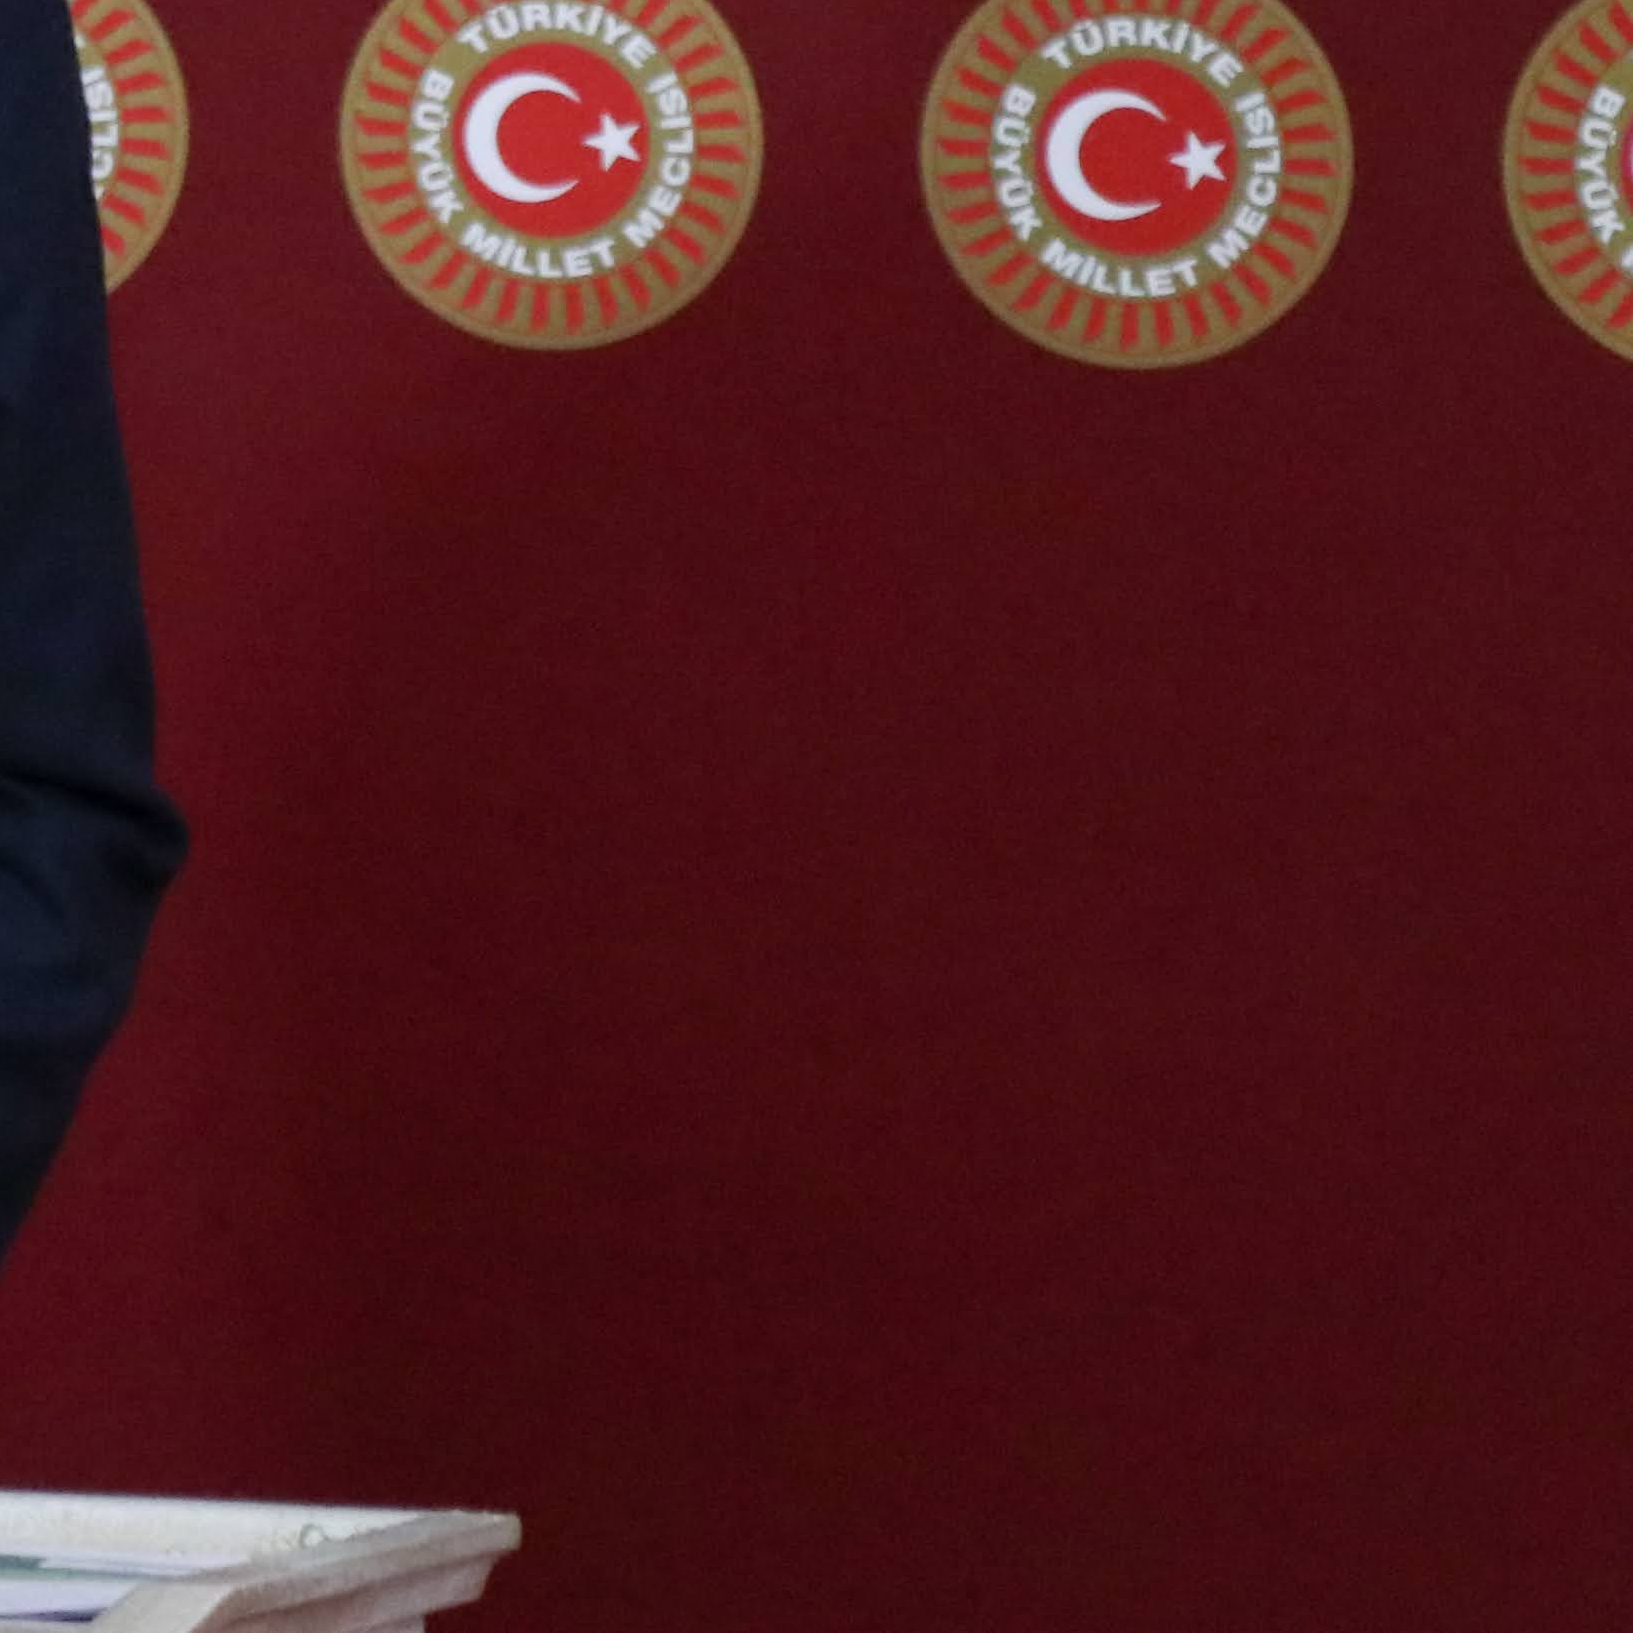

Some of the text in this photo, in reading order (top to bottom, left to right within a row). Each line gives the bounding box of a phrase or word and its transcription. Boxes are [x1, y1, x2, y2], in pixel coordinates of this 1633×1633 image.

[410, 0, 695, 278] TÜRKİYE BÜYÜK MİLLET MECLİSİ
[991, 16, 1281, 298] TÜRKİYE BÜYÜK MİLLET MECLİSİ
[1576, 85, 1625, 244] BÜYÜK
